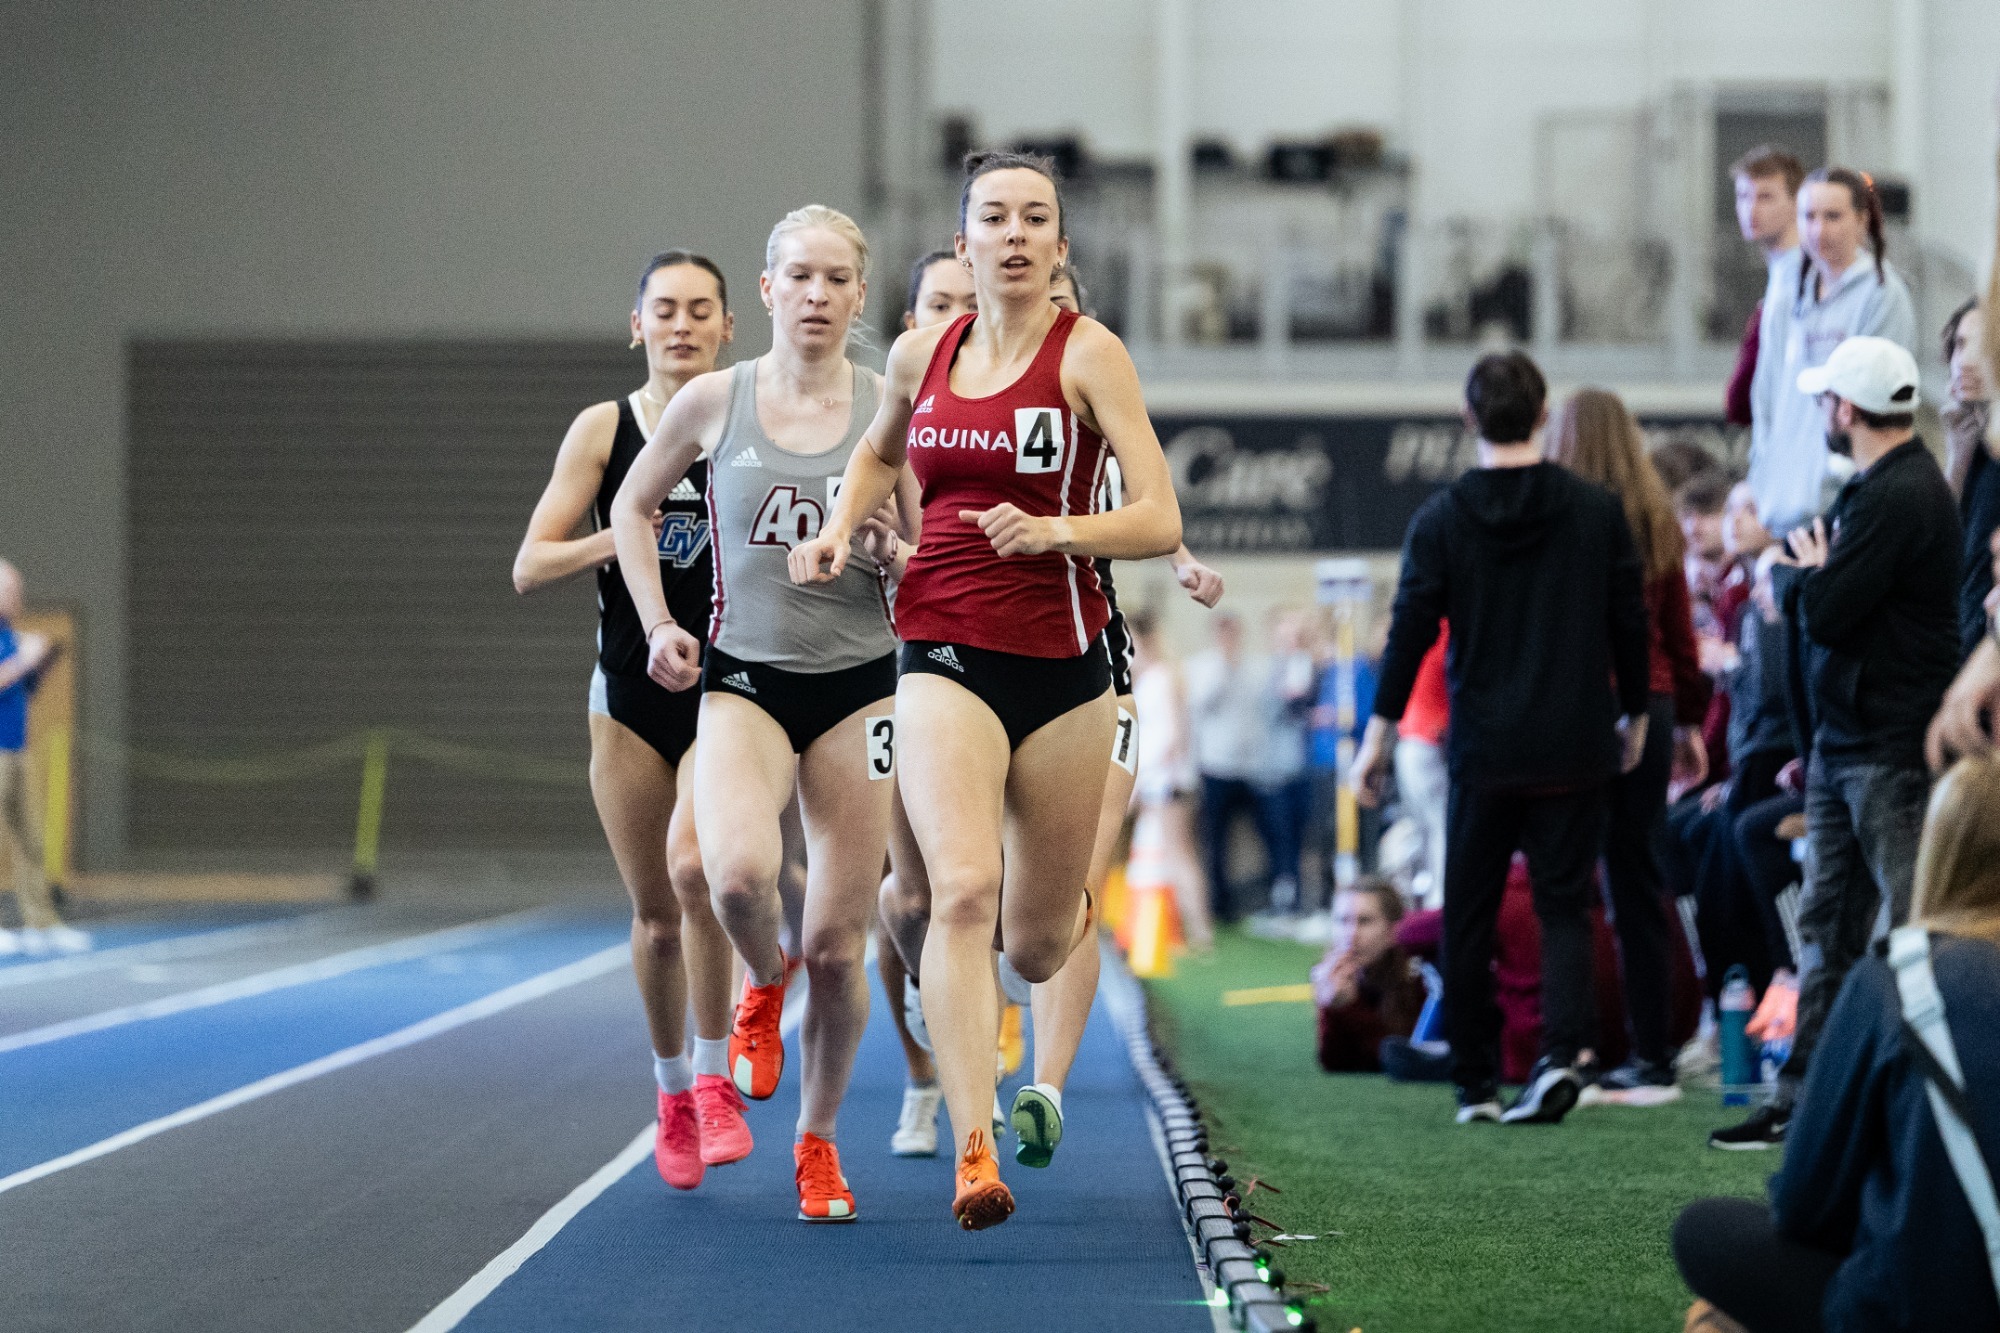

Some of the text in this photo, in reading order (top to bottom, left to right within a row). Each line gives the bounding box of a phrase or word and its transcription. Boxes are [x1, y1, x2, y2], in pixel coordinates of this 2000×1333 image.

[908, 426, 1018, 453] AQUINA
[1023, 412, 1058, 468] 4
[731, 459, 763, 468] adidas
[668, 492, 701, 501] adidas
[658, 511, 711, 568] GV
[928, 651, 965, 673] adidas
[722, 676, 757, 695] adidas
[872, 719, 895, 774] 3
